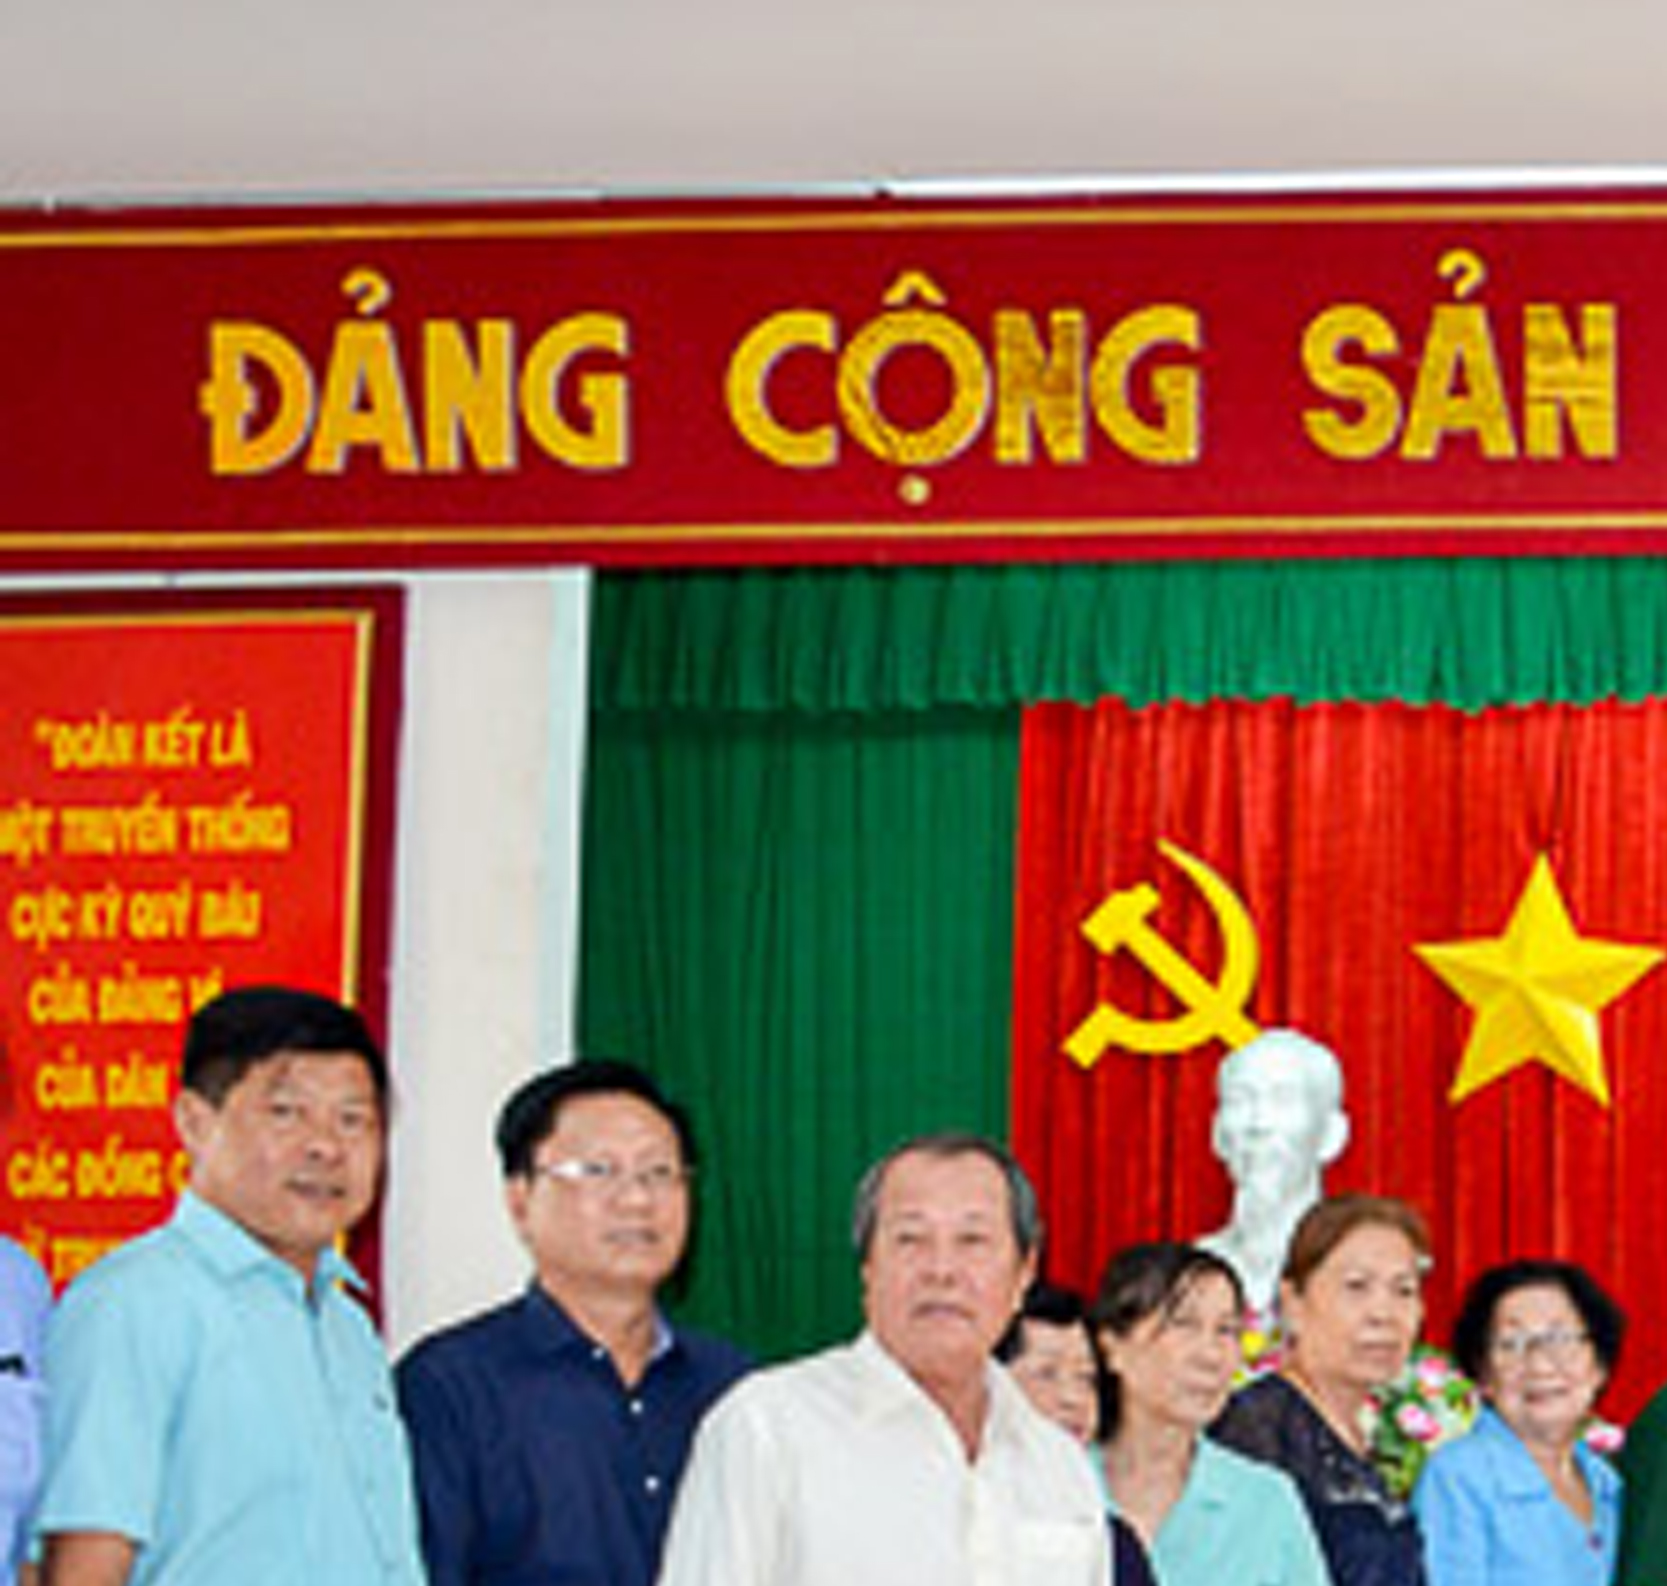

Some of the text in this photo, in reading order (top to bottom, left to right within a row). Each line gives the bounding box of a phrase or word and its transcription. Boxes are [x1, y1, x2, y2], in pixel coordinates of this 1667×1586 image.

[203, 267, 630, 475] ĐẢNG
[726, 271, 1201, 505] CỘNG
[1301, 250, 1617, 460] SẢN
